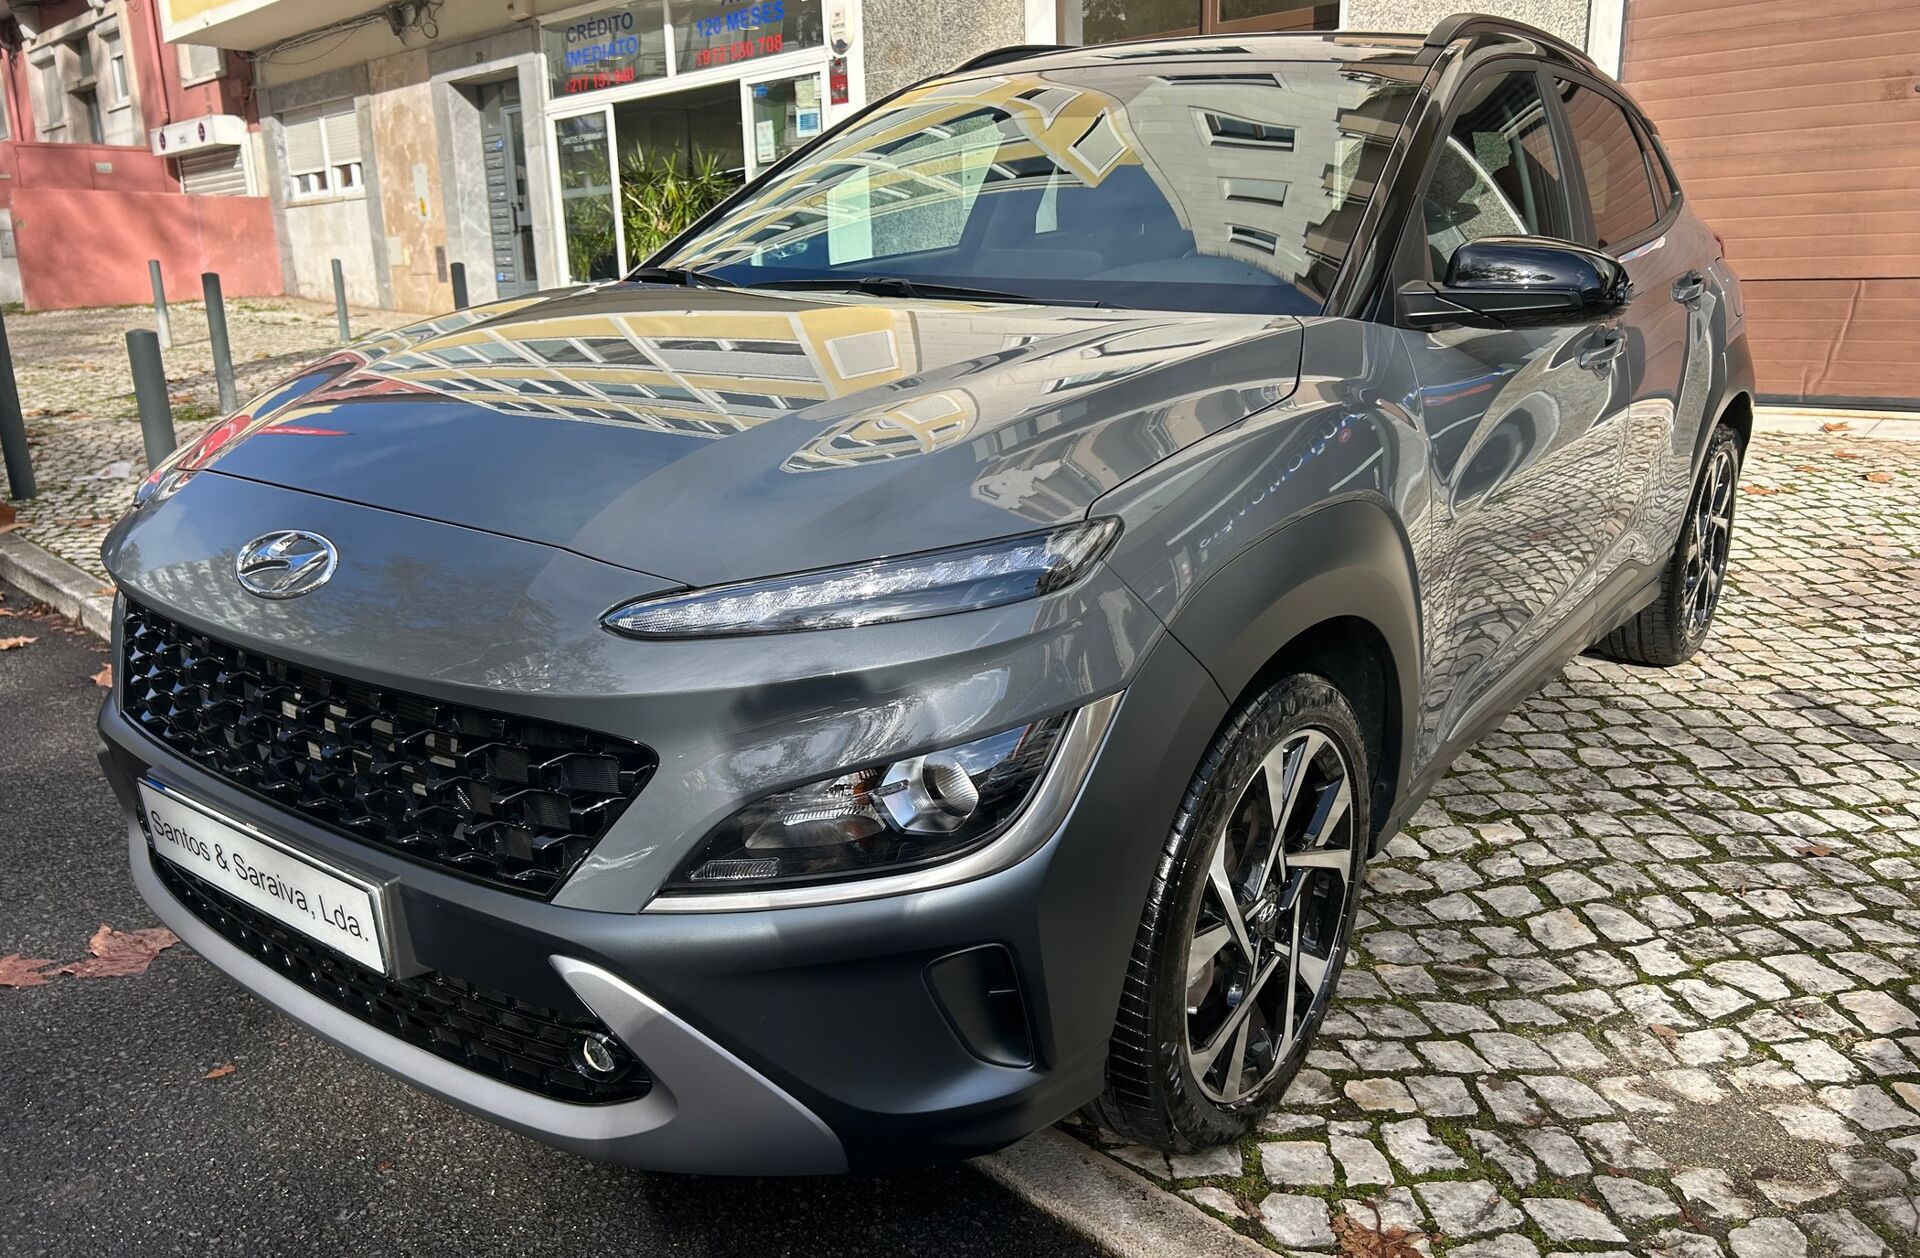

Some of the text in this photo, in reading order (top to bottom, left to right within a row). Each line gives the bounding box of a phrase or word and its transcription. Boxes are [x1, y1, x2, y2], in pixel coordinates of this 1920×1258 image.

[566, 12, 633, 43] CRÉDITO
[696, 1, 785, 38] 120 MESES
[565, 36, 638, 68] IMEDIATO
[757, 34, 783, 55] 708
[151, 810, 369, 942] Santos & Saraiva, Lda.
